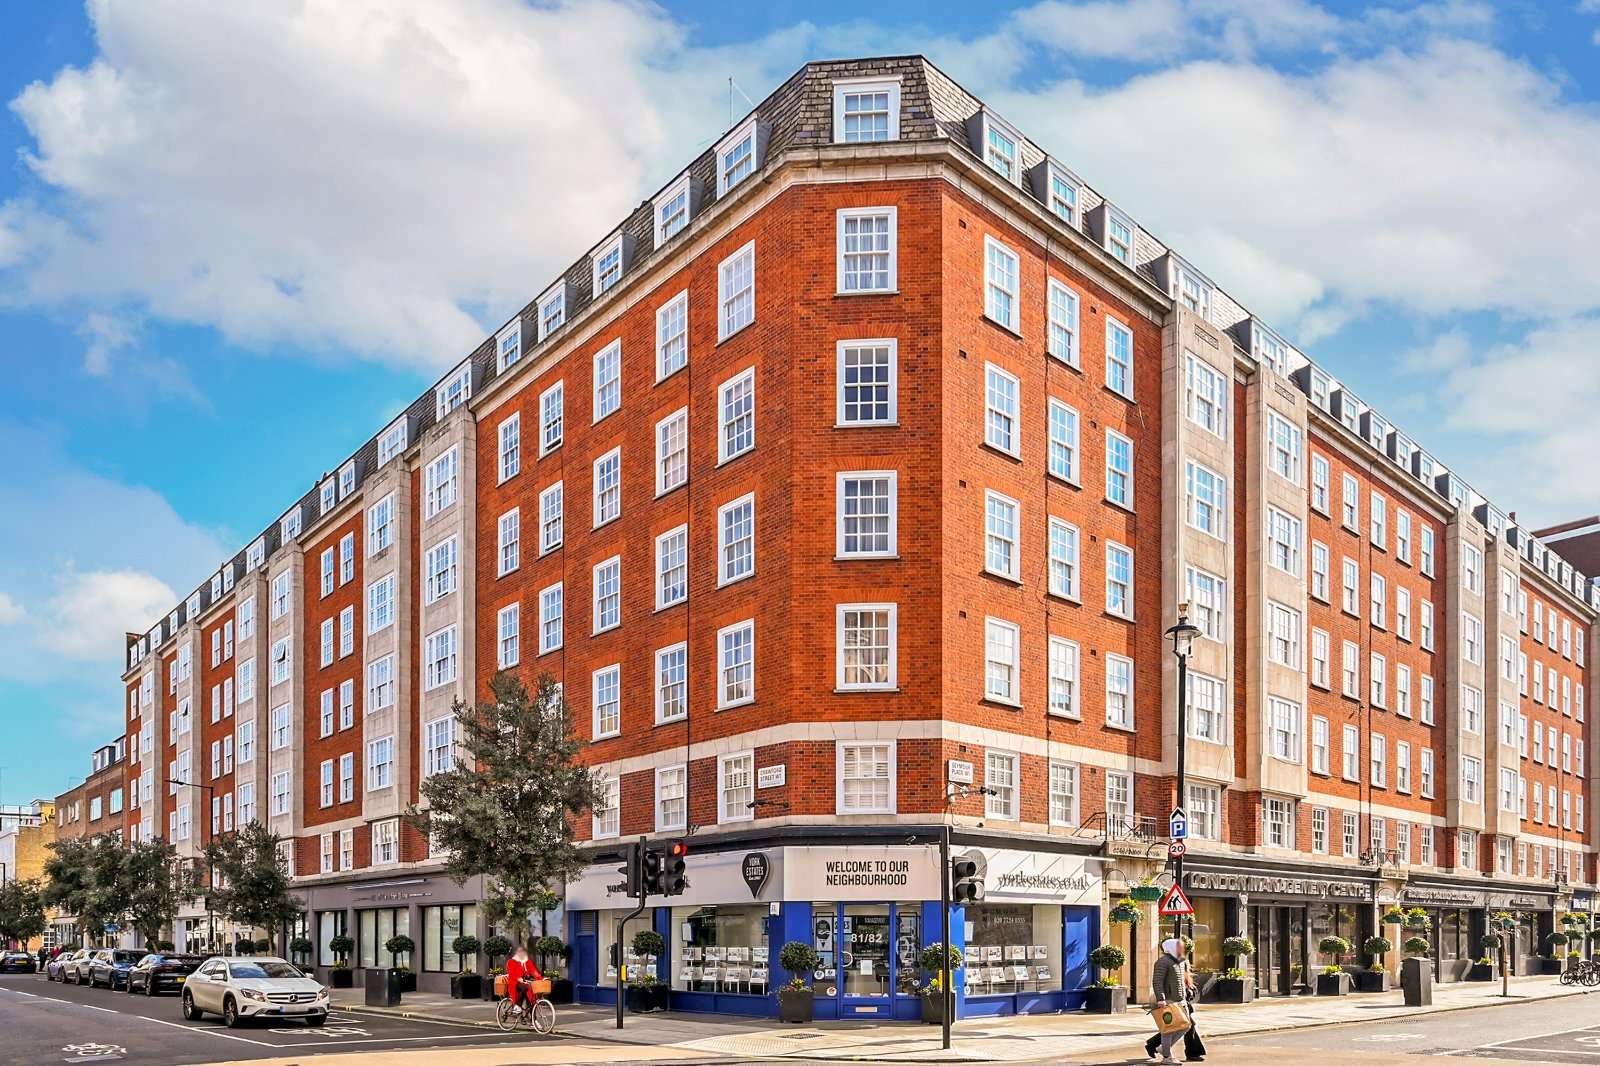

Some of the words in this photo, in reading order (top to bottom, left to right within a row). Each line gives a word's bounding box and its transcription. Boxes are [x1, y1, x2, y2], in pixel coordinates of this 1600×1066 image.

[1173, 822, 1183, 835] P
[748, 857, 760, 866] YORK
[826, 861, 872, 873] WELCOME
[875, 861, 887, 872] TO
[889, 861, 909, 872] OUR
[746, 866, 764, 876] ESTATES
[826, 874, 907, 886] NEIGHBOURHOOD
[1190, 872, 1249, 891] LONDON
[1250, 876, 1328, 896] MANAGEMENT
[1330, 881, 1372, 900] CENTRE
[851, 933, 882, 943] 81/82
